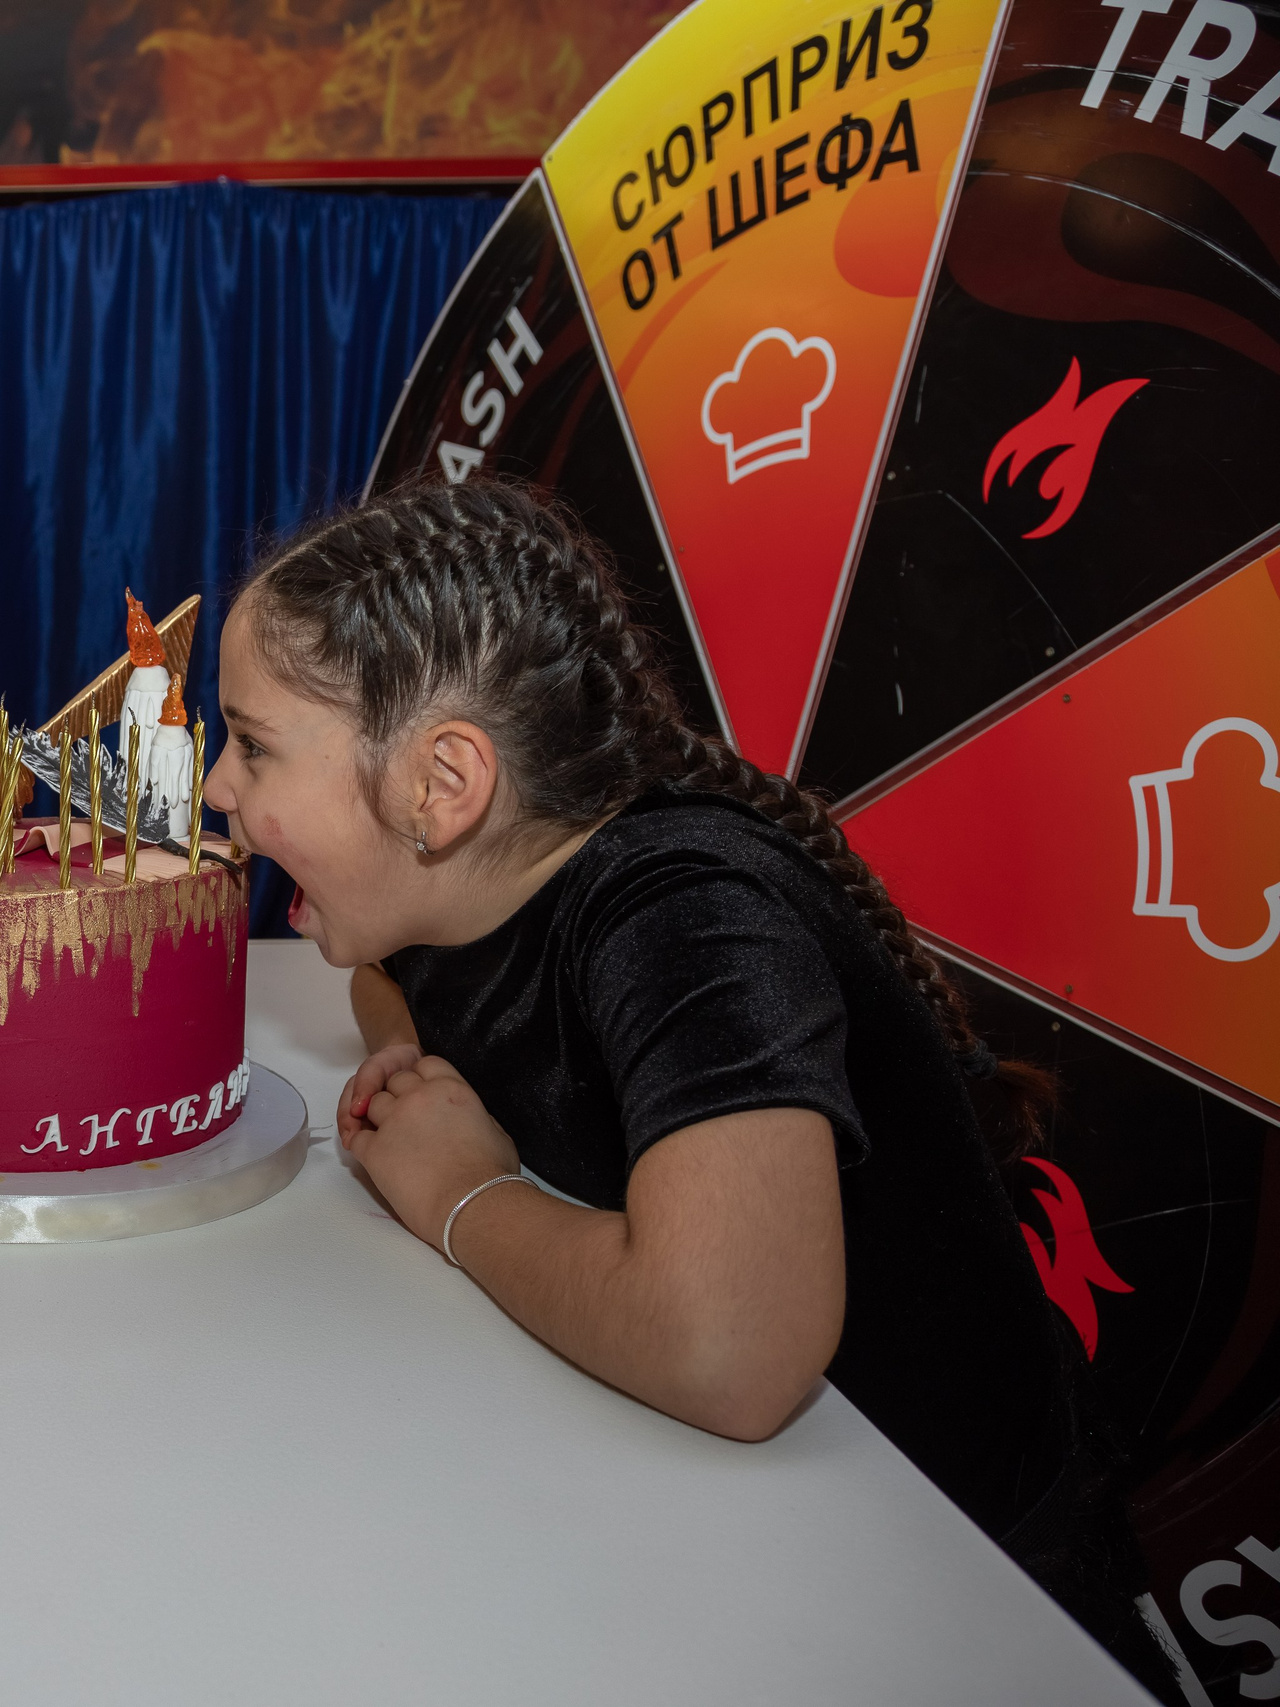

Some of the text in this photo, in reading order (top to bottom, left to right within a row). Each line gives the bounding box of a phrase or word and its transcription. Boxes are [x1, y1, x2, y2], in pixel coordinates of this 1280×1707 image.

[611, 0, 934, 232] СЮРПРИЗ
[1080, 0, 1280, 177] TRA
[621, 97, 921, 311] ОТ ШЕФА
[437, 306, 544, 486] ASH
